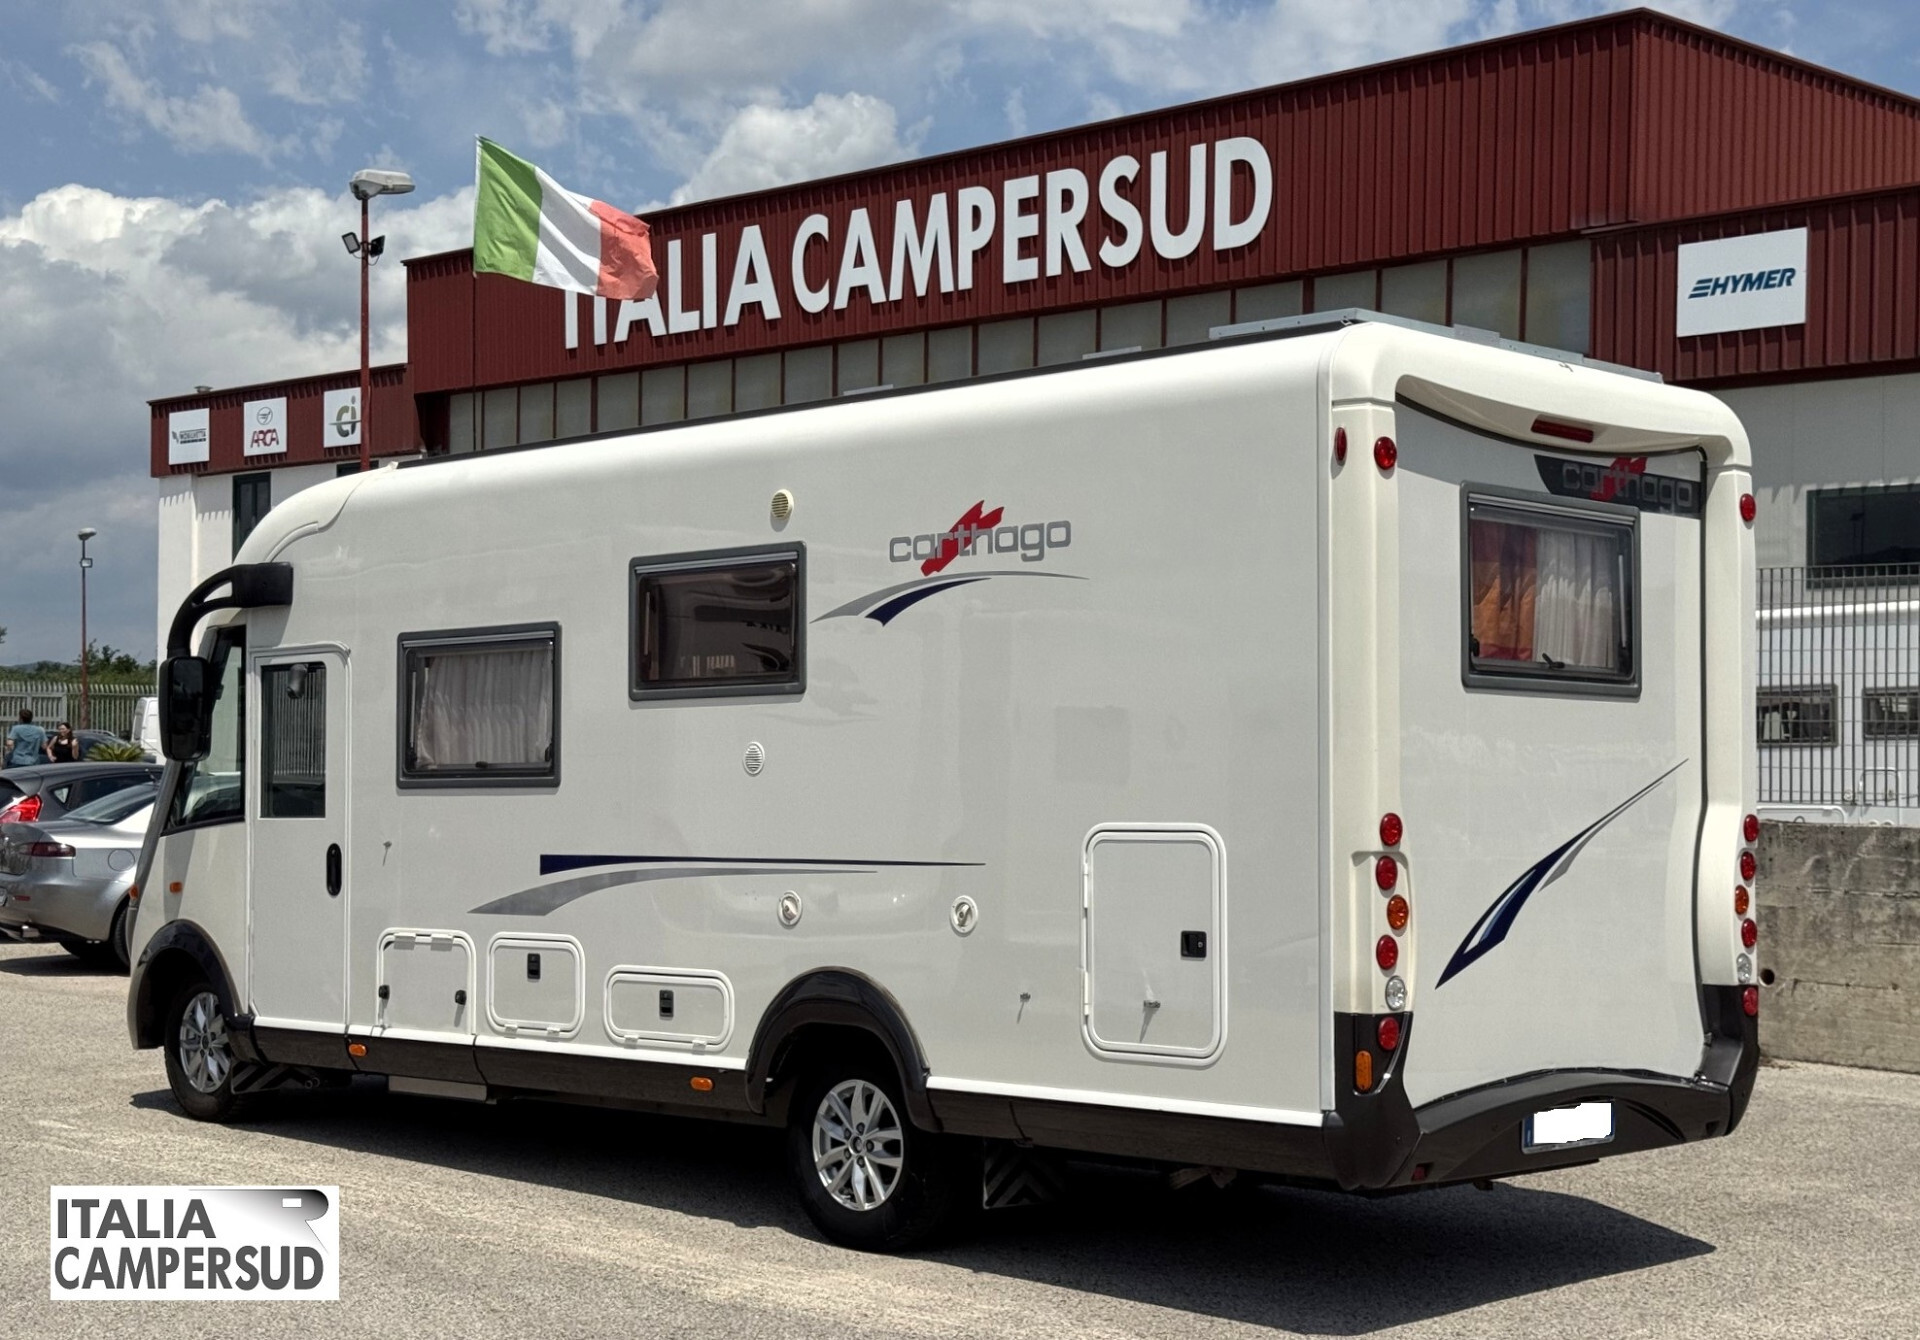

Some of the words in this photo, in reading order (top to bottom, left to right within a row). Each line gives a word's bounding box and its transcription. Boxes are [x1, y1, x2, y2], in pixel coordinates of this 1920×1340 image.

[791, 136, 1273, 314] CAMPERSUD
[1709, 267, 1797, 297] HYMER
[250, 428, 280, 448] ARCA
[1562, 462, 1693, 516] carthago
[889, 520, 1072, 562] carthago
